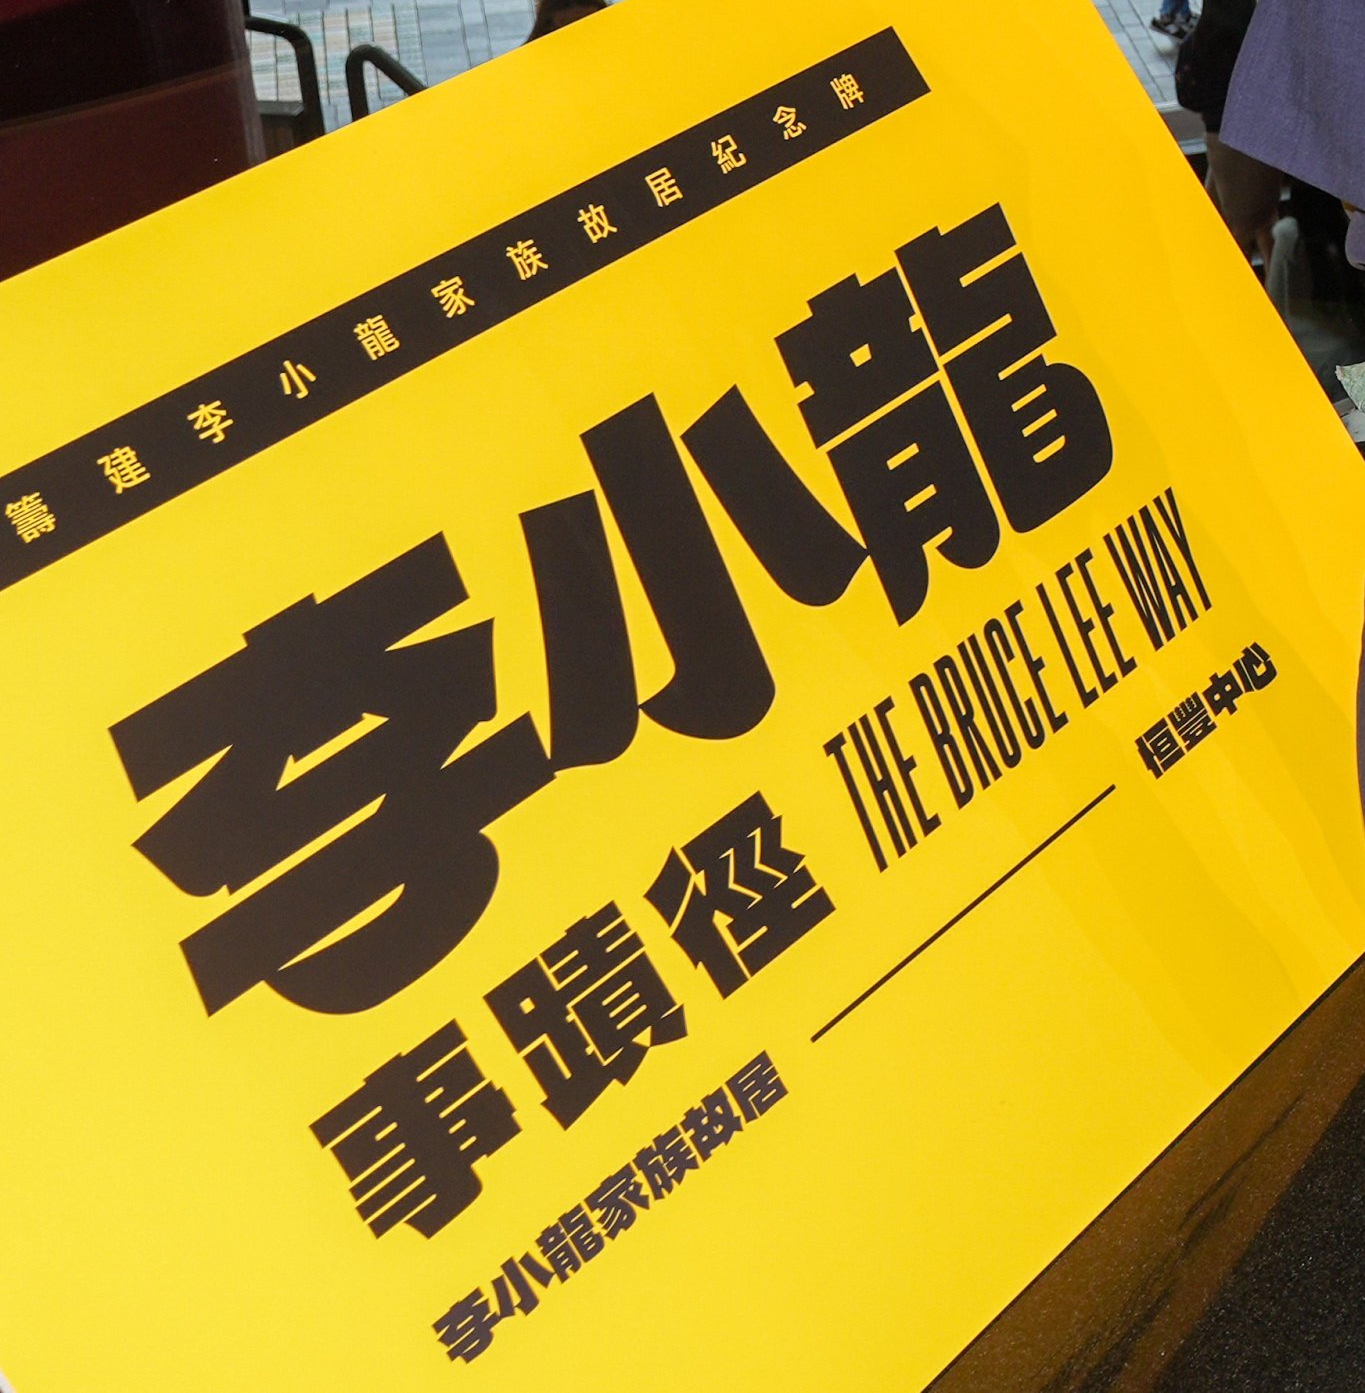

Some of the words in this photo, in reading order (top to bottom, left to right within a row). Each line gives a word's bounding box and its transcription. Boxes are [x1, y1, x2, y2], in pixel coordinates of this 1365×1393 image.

[4, 73, 867, 544] 籌建李小龍家族故居紀念牌
[108, 202, 1113, 1017] 李小龍
[824, 699, 939, 871] THE
[913, 600, 1067, 808] BRUCE
[1036, 550, 1134, 709] LEE
[1103, 489, 1212, 652] WAY
[1135, 642, 1278, 780] 恒豐中心
[308, 789, 837, 1239] 事蹟徑
[431, 1049, 789, 1363] 李小龍家族故居
